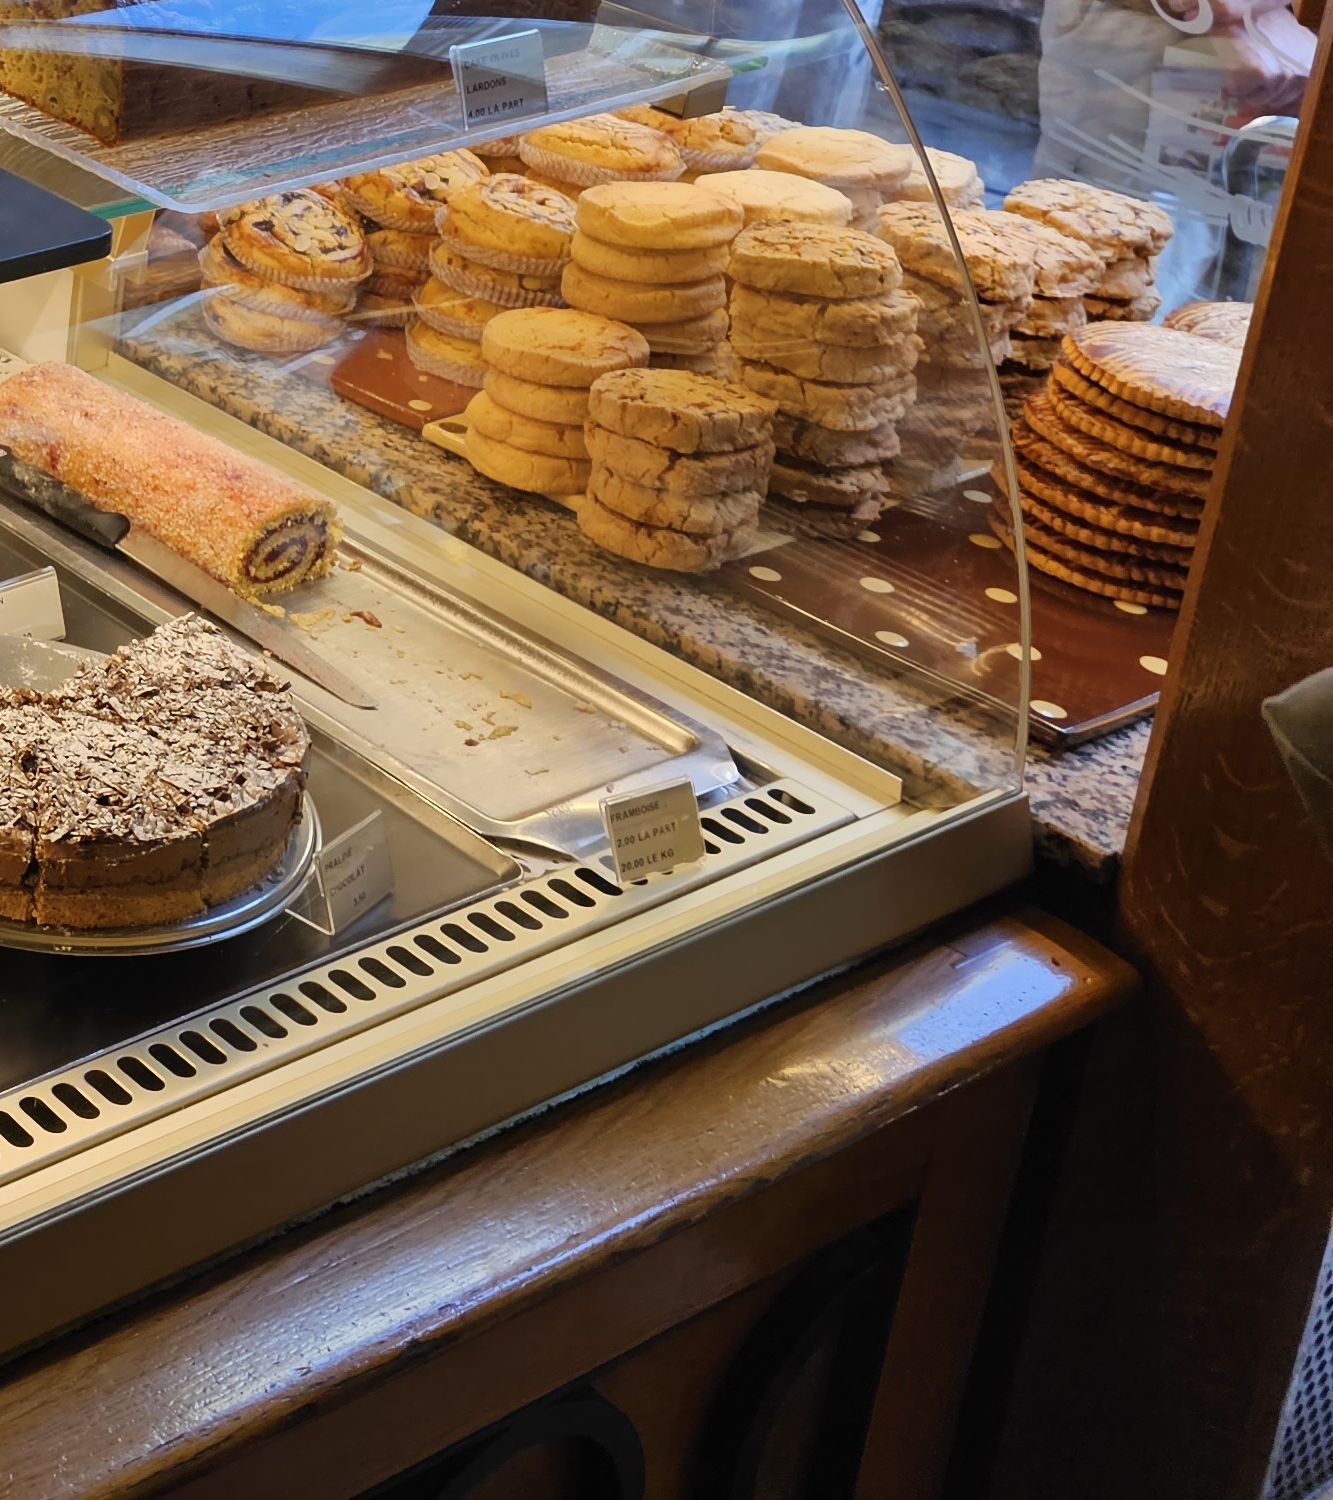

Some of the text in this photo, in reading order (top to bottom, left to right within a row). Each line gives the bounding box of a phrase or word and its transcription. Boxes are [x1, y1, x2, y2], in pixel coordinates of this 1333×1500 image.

[490, 47, 521, 63] OLIVES
[466, 76, 507, 95] LARDONS
[488, 104, 499, 115] LA
[502, 98, 524, 111] PART
[610, 800, 660, 824] FRAMBOISE
[638, 831, 650, 842] LA
[653, 822, 676, 837] PART
[646, 852, 658, 865] LE
[660, 848, 674, 860] KG
